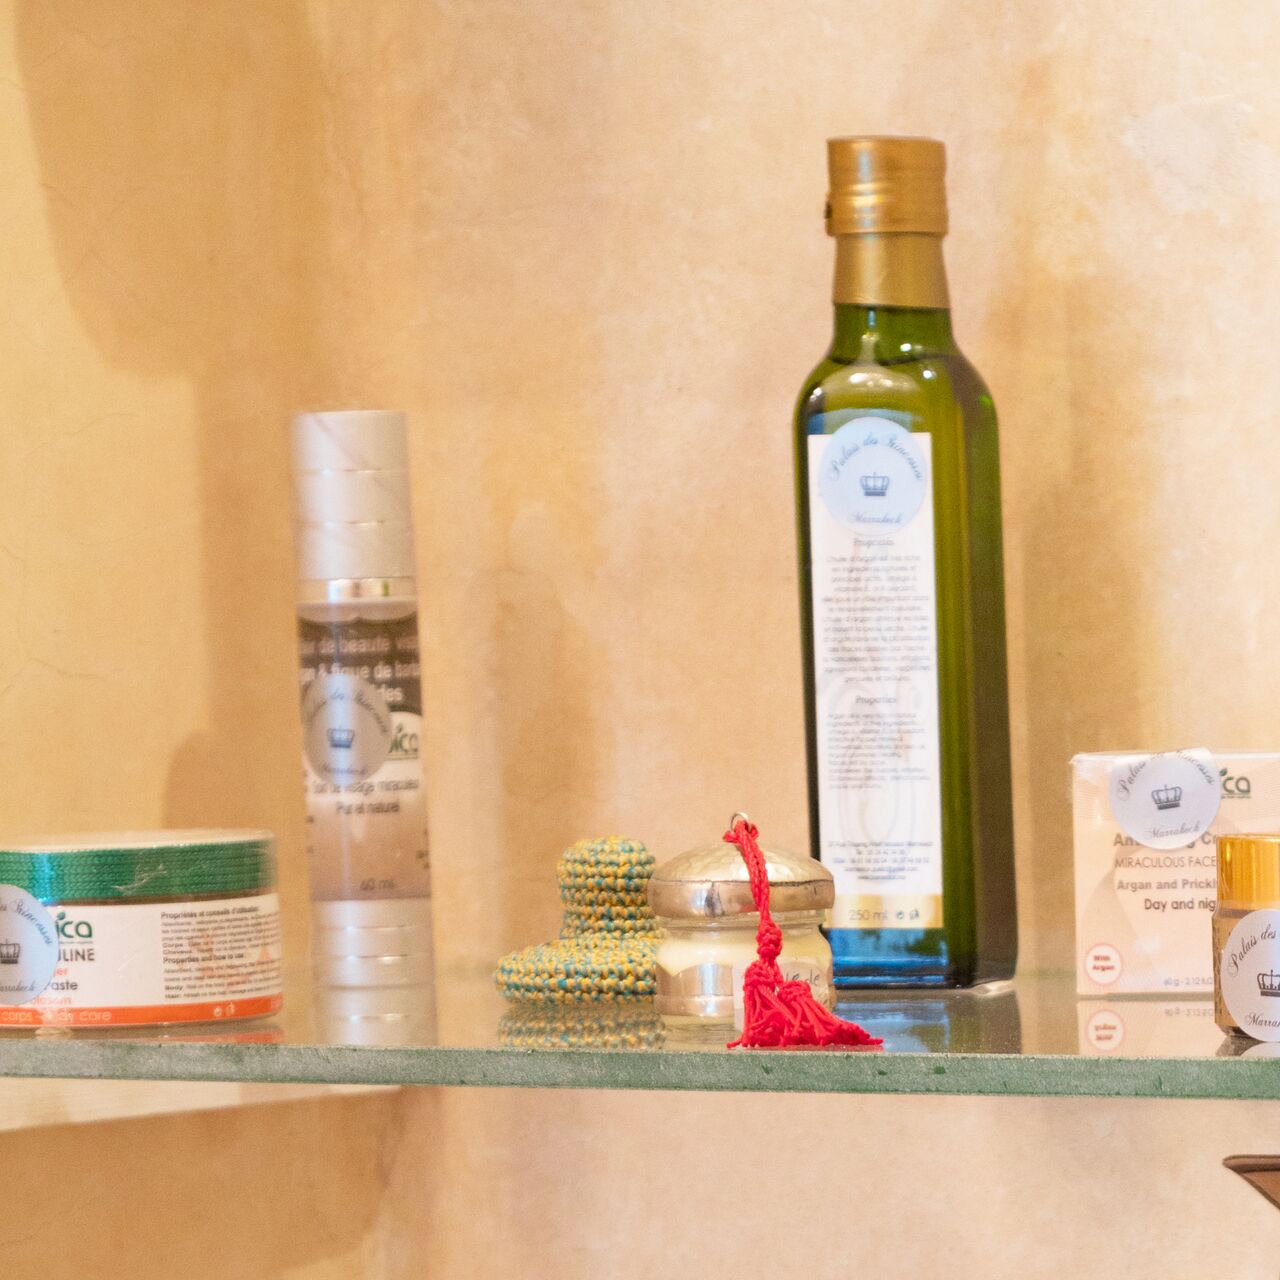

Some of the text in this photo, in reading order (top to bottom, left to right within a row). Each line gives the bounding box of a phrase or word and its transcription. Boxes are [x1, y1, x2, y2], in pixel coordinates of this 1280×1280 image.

[1115, 855, 1217, 868] MIRACULOUS FACE
[1118, 879, 1177, 892] Argan and
[1144, 897, 1217, 912] Day and nig
[848, 909, 871, 921] 250
[1227, 934, 1258, 978] Palais
[1260, 923, 1277, 940] des
